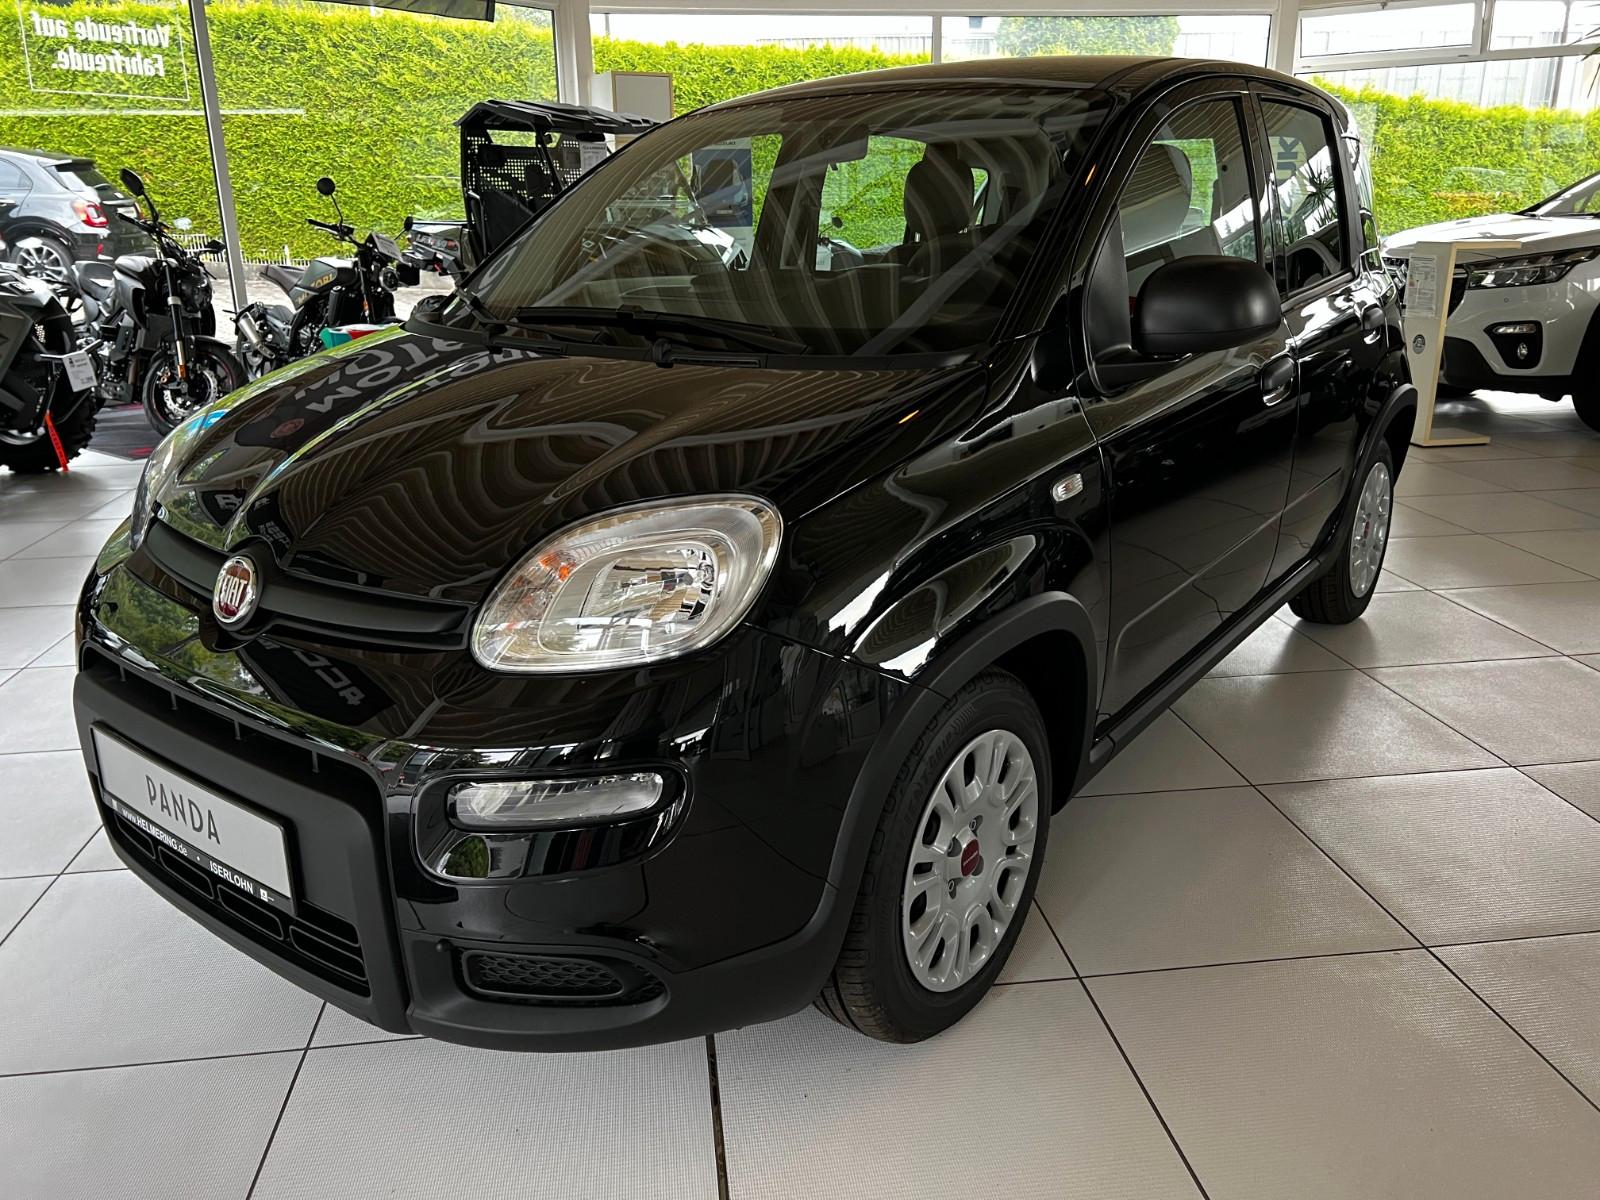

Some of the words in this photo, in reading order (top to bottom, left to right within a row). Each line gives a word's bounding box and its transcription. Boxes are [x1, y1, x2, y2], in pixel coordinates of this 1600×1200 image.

[219, 574, 249, 607] FIAT
[145, 774, 221, 845] PANDA
[122, 808, 188, 856] www.HELMERING.de
[209, 860, 254, 894] ISERLOHN
